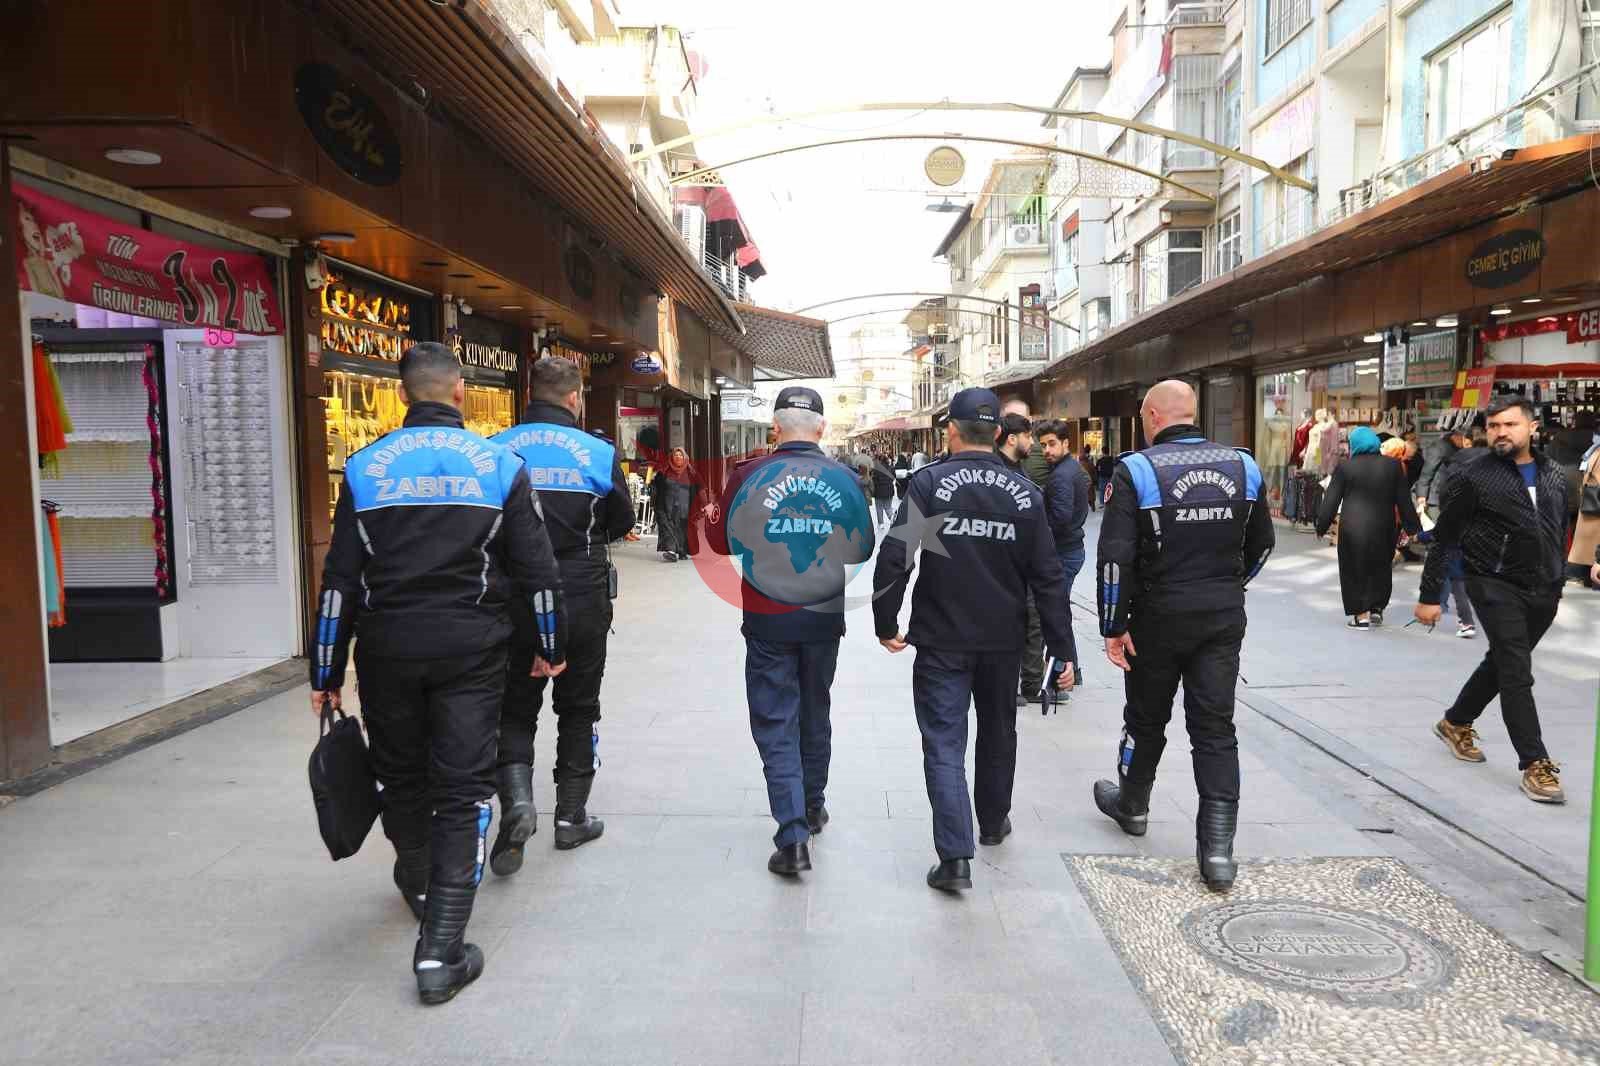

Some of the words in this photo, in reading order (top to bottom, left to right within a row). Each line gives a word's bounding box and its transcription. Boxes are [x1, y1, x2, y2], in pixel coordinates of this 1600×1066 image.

[107, 234, 140, 260] TÜM
[92, 282, 179, 321] ÜRÜNLERİNDE
[465, 342, 518, 373] KUYUMCULUK
[376, 476, 484, 501] ZABITA
[763, 474, 842, 512] BÜYÜKŞEHİR
[935, 468, 1032, 511] BÜYÜKŞEHİR
[1172, 470, 1237, 500] BÜYÜKŞEHİR
[768, 518, 834, 534] ZABITA
[1176, 507, 1233, 521] ZABITA
[943, 517, 1017, 541] ZABITA
